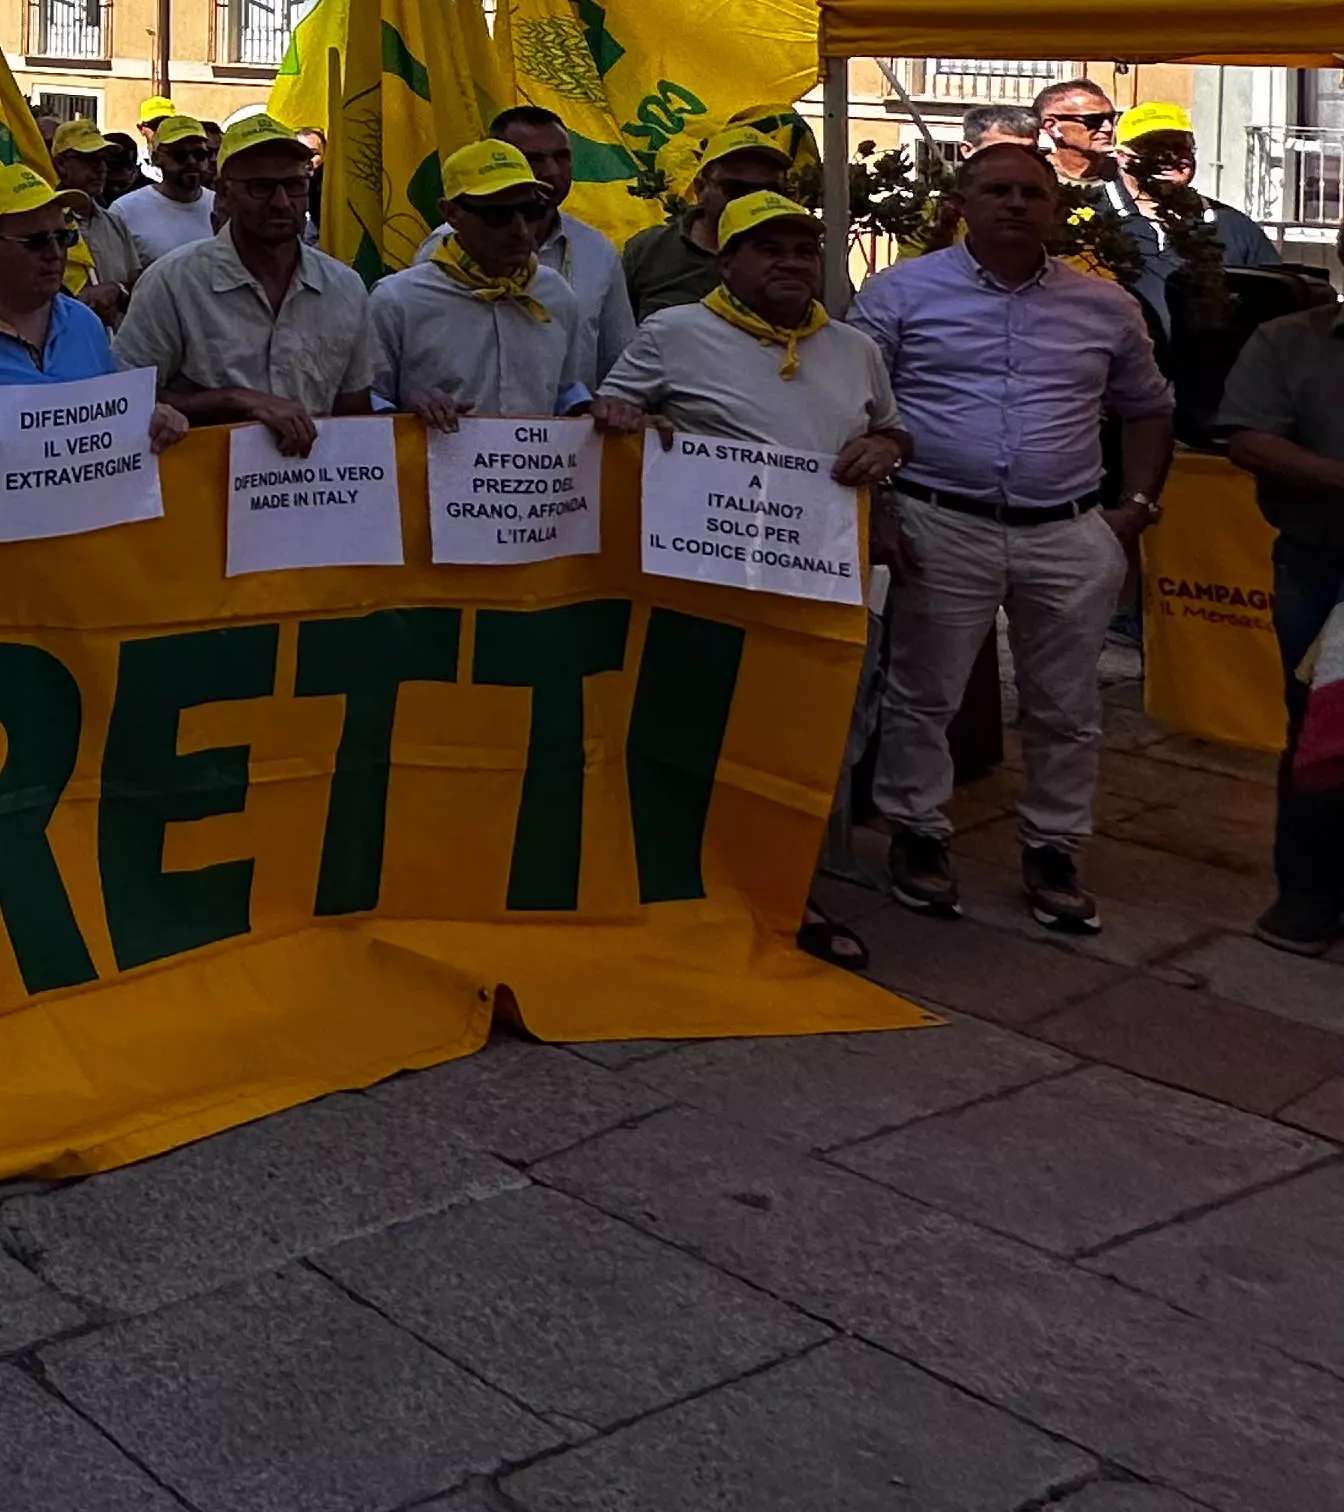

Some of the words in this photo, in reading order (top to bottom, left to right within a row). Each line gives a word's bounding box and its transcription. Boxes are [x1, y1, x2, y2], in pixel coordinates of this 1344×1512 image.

[20, 397, 128, 430] DIFENDIAMO
[44, 441, 61, 457] IL
[66, 432, 112, 455] VERO
[514, 427, 548, 443] CHI
[474, 453, 563, 469] AFFONDA
[567, 453, 577, 467] IL
[682, 441, 710, 457] DA
[716, 445, 819, 473] STRANIERO
[5, 453, 142, 490] EXTRAVERGINE
[234, 468, 315, 491] DIFENDIAMO
[319, 468, 333, 482] IL
[336, 466, 384, 481] VERO
[748, 475, 762, 489] A
[472, 478, 548, 494] PREZZO
[552, 477, 574, 493] DEL
[250, 493, 289, 510] MADE
[294, 492, 308, 506] IN
[313, 489, 358, 506] ITALY
[446, 502, 523, 521] GRANO,
[528, 496, 588, 518] AFFONDA
[708, 493, 803, 519] ITALIANO?
[496, 526, 557, 544] L'ITALIA
[706, 518, 759, 537] SOLO
[764, 526, 800, 545] PER
[650, 534, 666, 548] IL
[672, 537, 746, 561] CODICE
[752, 550, 852, 578] DOGANALE
